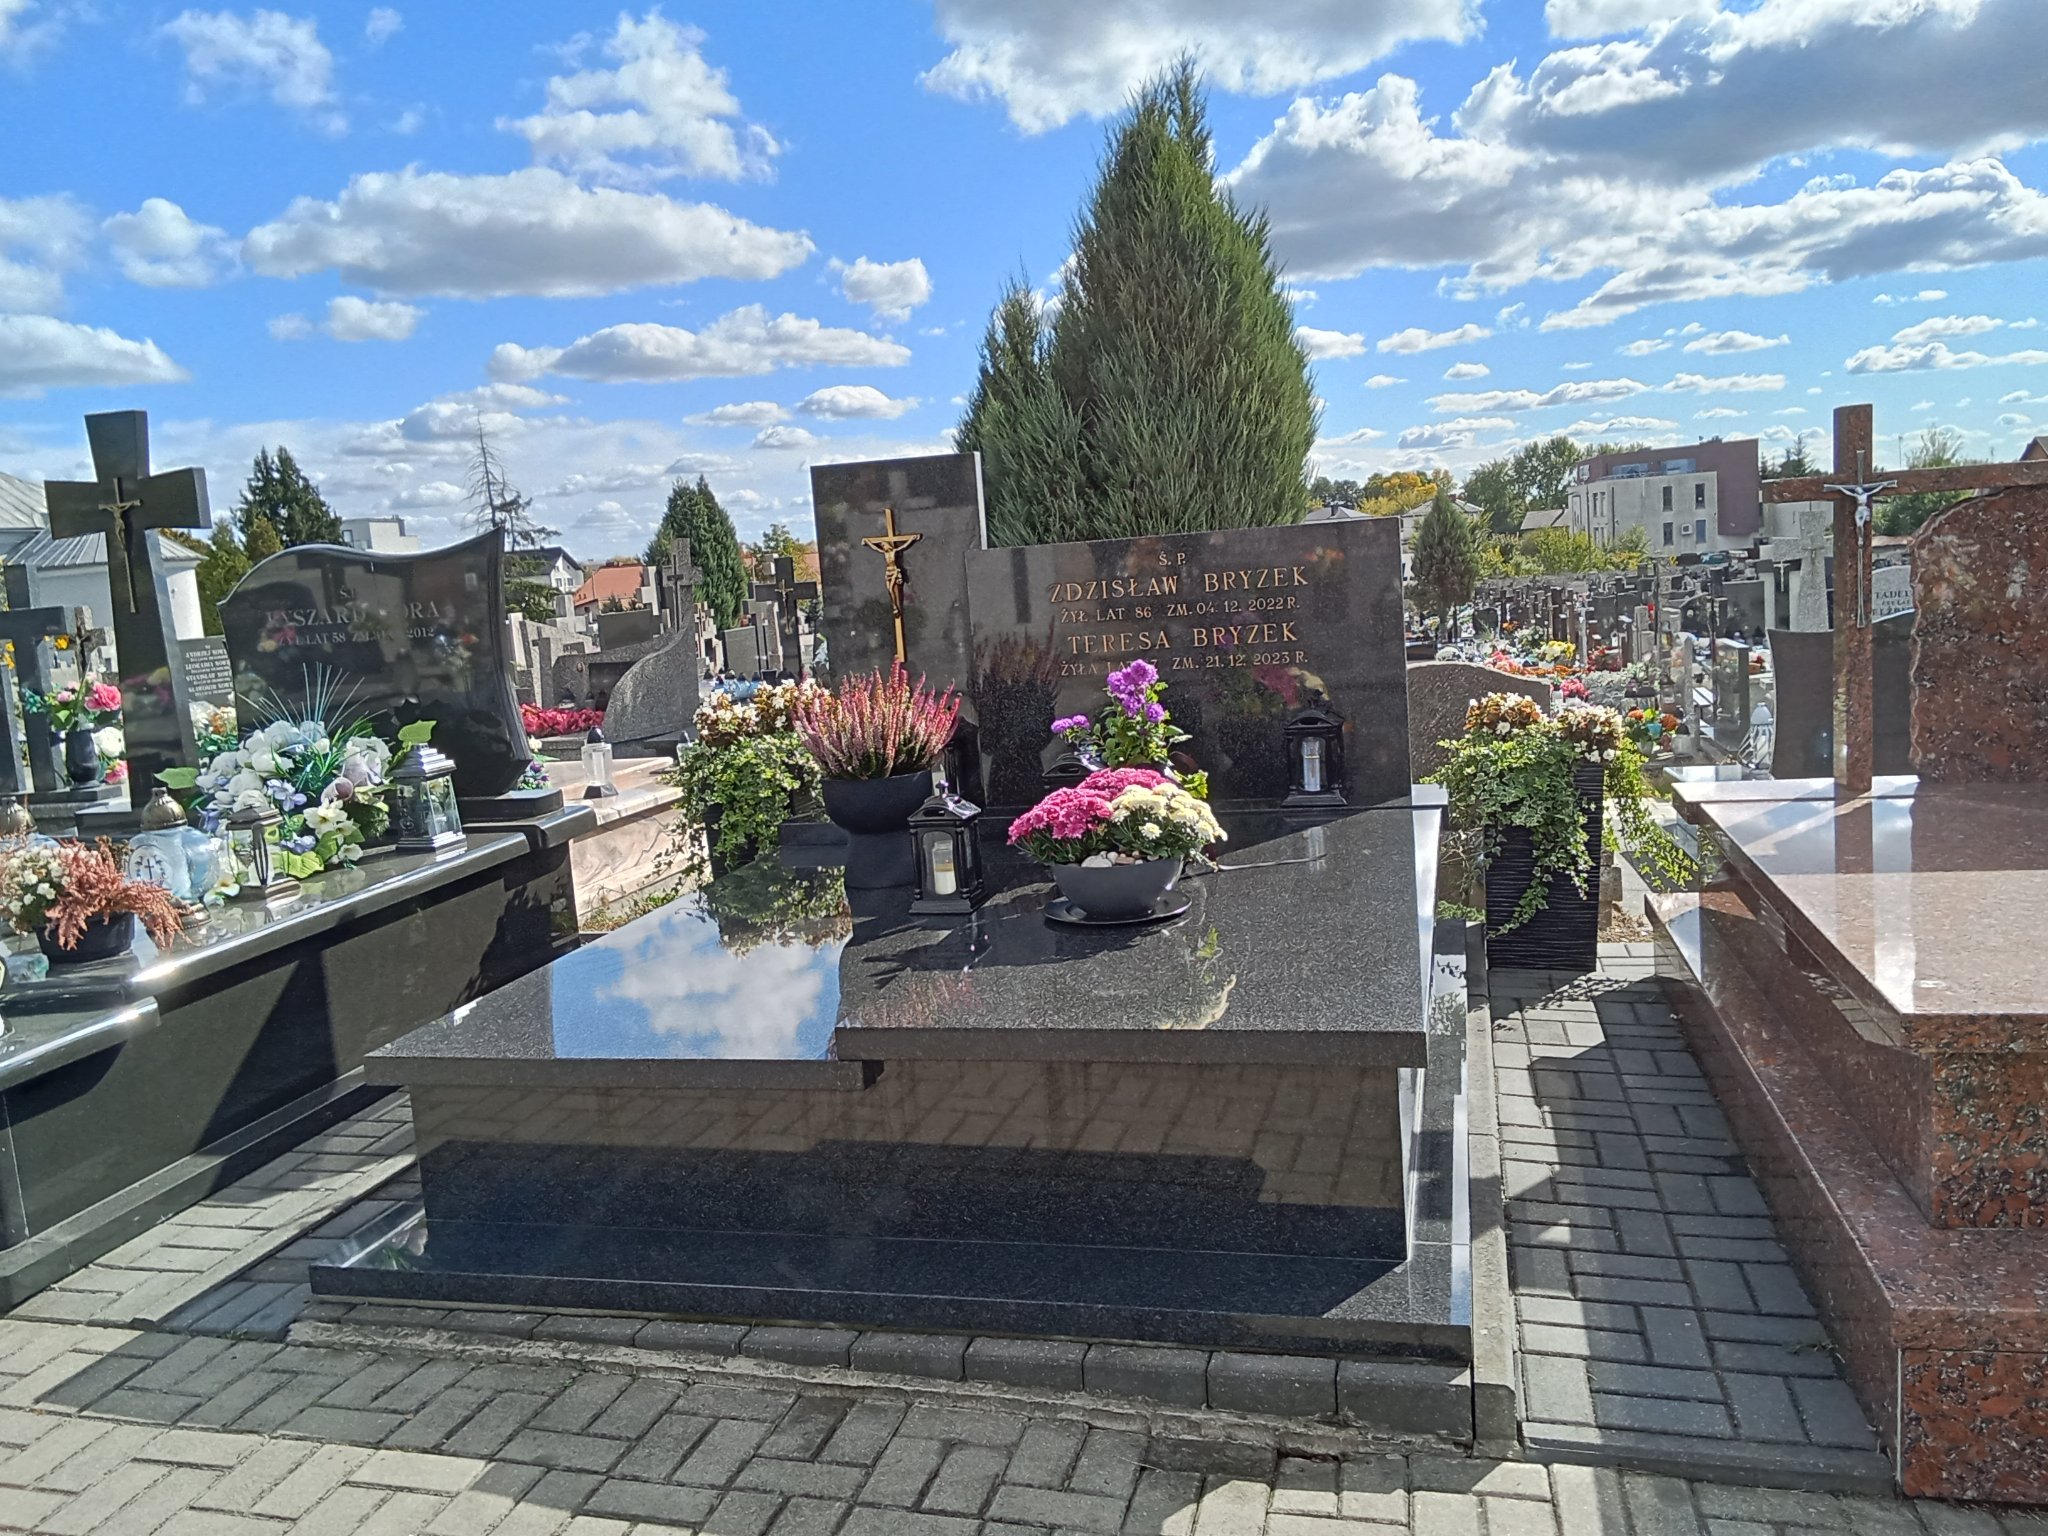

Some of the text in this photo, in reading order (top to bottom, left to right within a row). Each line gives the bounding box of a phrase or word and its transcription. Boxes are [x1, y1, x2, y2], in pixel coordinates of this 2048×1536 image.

[1050, 566, 1309, 603] ZDZISŁAW BRYZEK
[1096, 607, 1125, 621] LAT
[1135, 606, 1152, 619] 86
[332, 631, 346, 643] 58
[406, 626, 435, 639] 2012
[1068, 621, 1298, 655] TERESA BRYZEK
[1060, 661, 1097, 677] ŻYŁA
